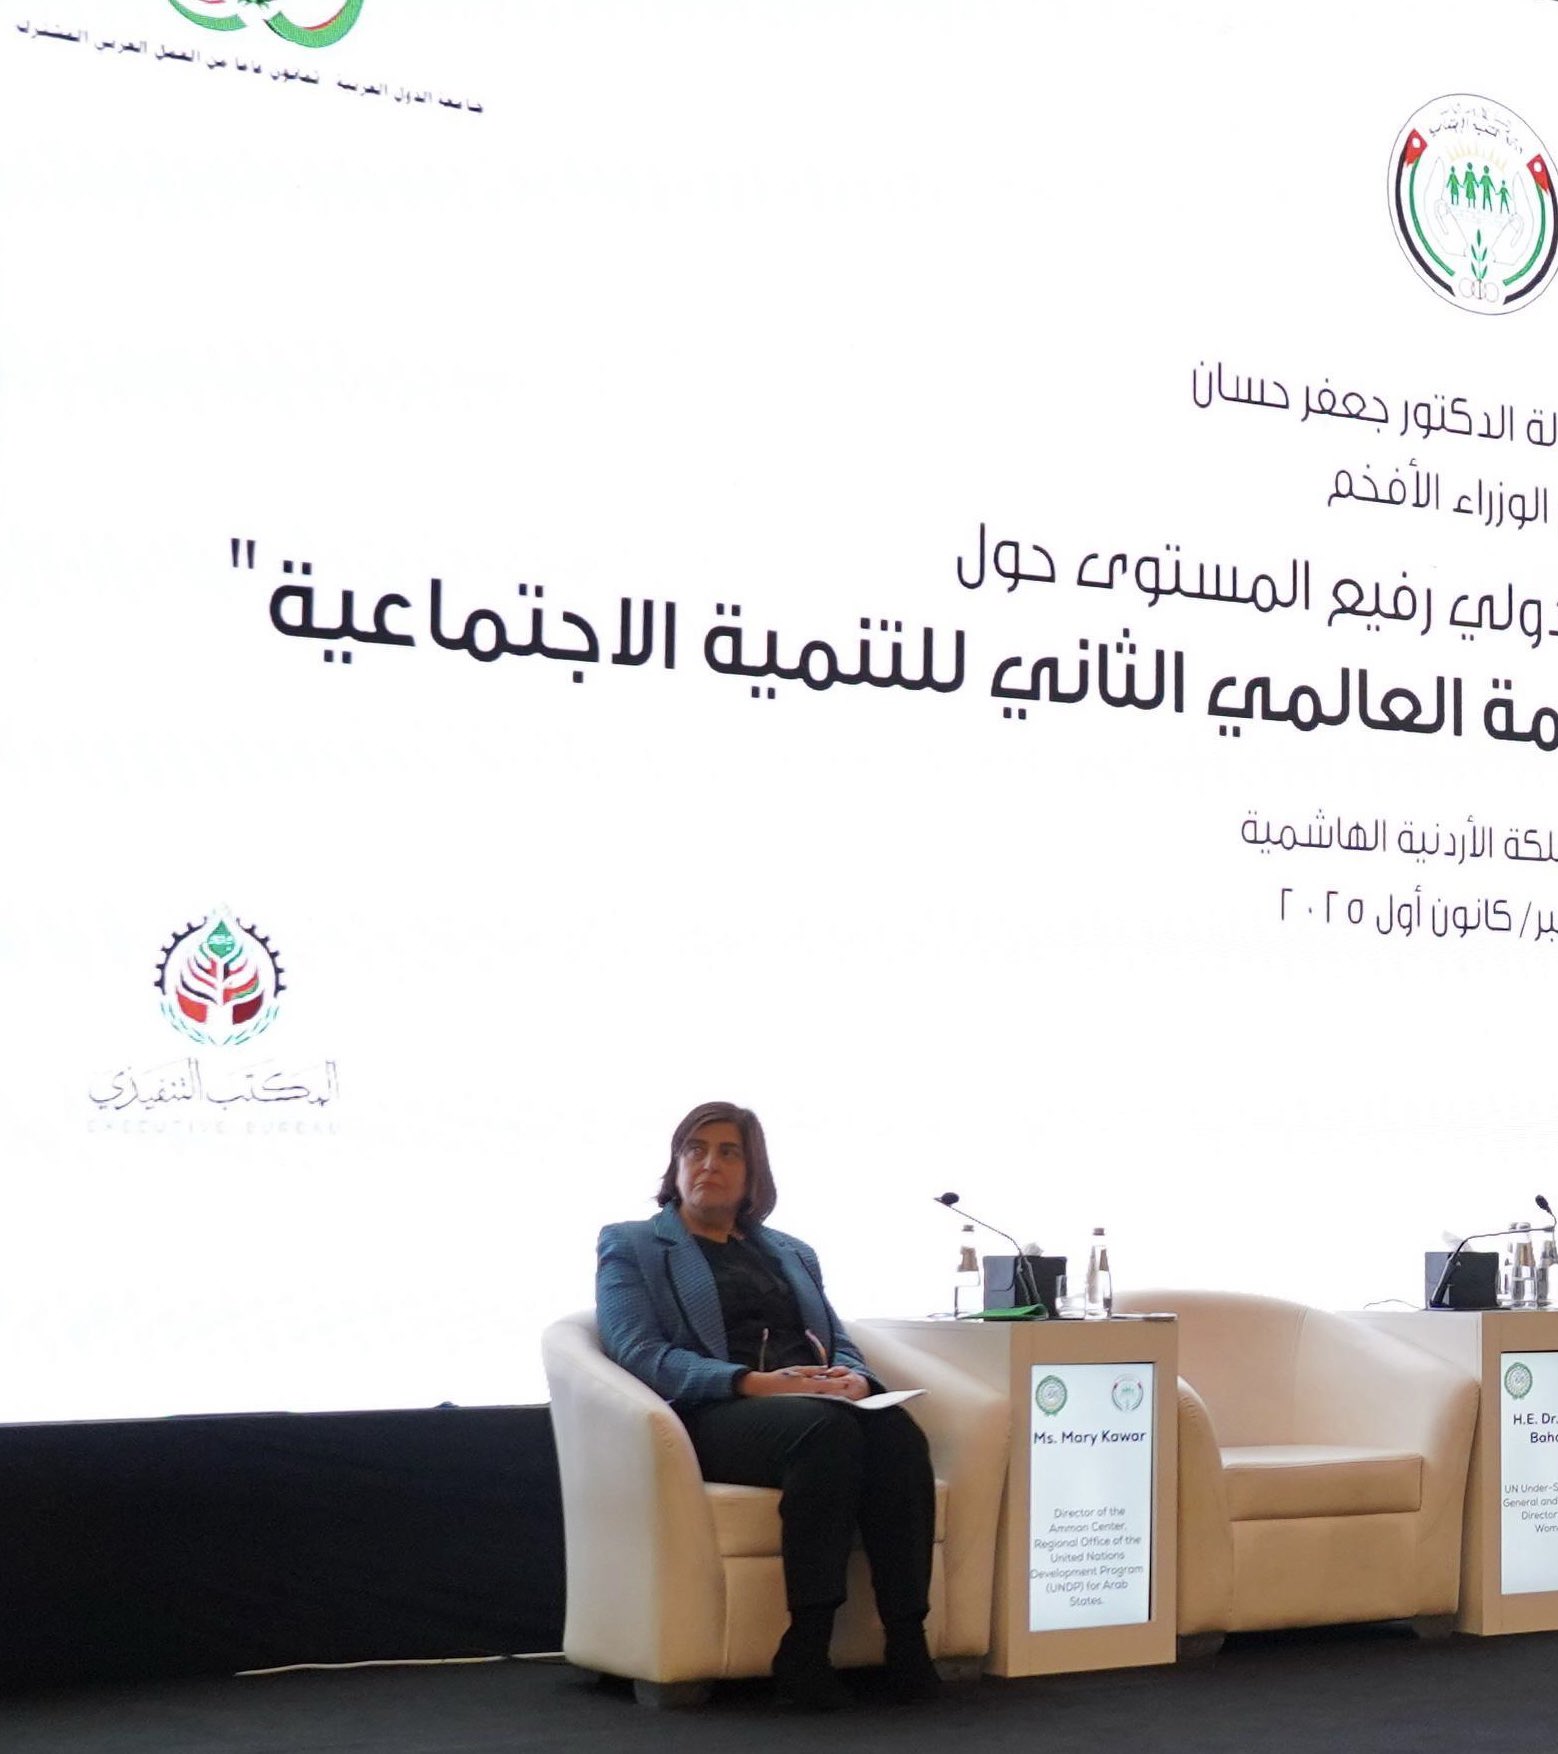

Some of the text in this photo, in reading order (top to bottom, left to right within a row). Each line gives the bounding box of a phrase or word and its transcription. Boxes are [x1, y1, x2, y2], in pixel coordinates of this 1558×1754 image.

[1193, 362, 1289, 409] حسان
[1301, 378, 1388, 433] جعفر
[1400, 395, 1513, 441] الدكتور
[1328, 458, 1439, 509] الأفخم
[1453, 479, 1547, 529] الوزراء
[957, 524, 1056, 593] حول
[1077, 553, 1310, 615] المستوى
[1331, 570, 1428, 637] رفيع
[703, 603, 966, 700] للتنمية
[990, 628, 1185, 719] الثاني
[1207, 667, 1462, 738] العالمي
[1242, 809, 1386, 854] الهاشمية
[1398, 815, 1493, 864] الأردنية
[1281, 888, 1364, 925] ٢٠٢٥
[1376, 885, 1421, 935] أول
[207, 1057, 340, 1109] المكتب
[1034, 1430, 1146, 1446] Ms. Mary Kawar
[1513, 1413, 1538, 1425] H.E.
[1541, 1412, 1558, 1424] Dr.
[1503, 1498, 1539, 1508] General
[1540, 1496, 1558, 1506] and
[1504, 1484, 1518, 1494] UN
[1049, 1523, 1089, 1533] Amman
[1054, 1507, 1125, 1518] Director of the
[1522, 1510, 1557, 1520] Director
[1035, 1536, 1142, 1552] Regional Office of the
[1050, 1551, 1125, 1563] United Nations
[1030, 1566, 1143, 1579] Development Program
[1046, 1579, 1128, 1593] (UNDP) for Arab
